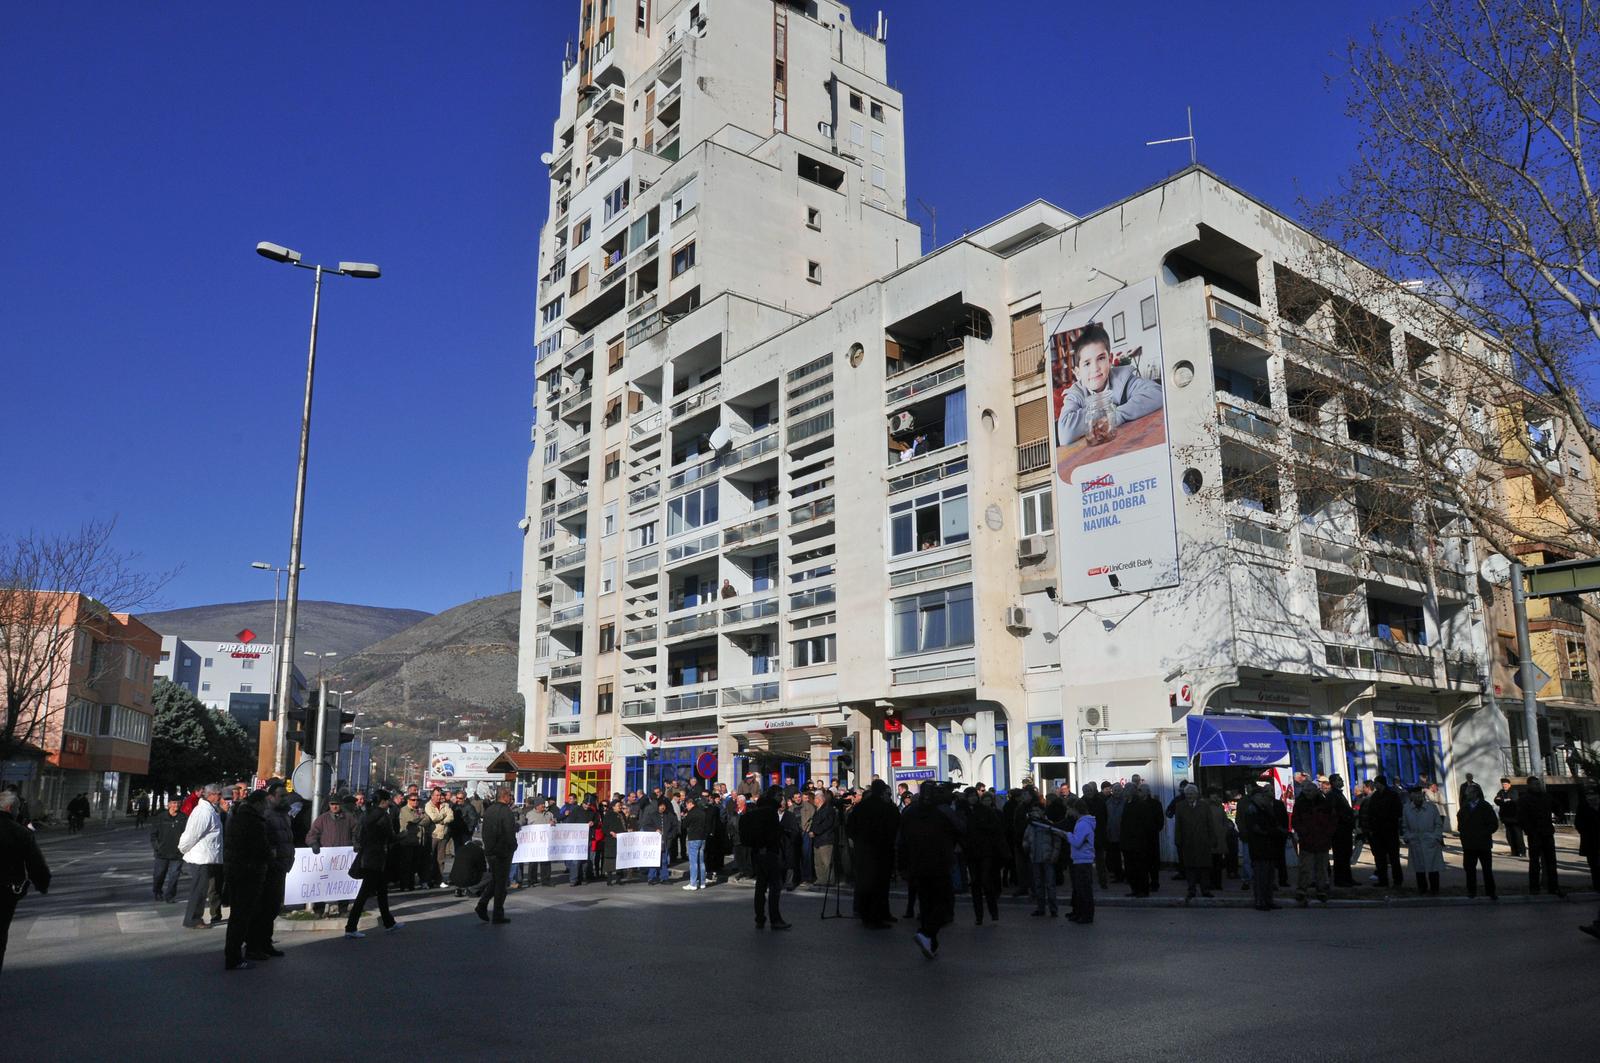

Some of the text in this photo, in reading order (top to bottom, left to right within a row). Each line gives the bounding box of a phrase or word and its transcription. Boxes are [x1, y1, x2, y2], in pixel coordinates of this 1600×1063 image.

[1082, 477, 1157, 505] ŠTEDNJA JESTE
[1083, 494, 1146, 518] MOJA DOBRA
[1084, 514, 1121, 532] NAVIKA.
[1109, 561, 1136, 572] UniCredit
[1136, 558, 1152, 568] Bank
[577, 750, 605, 763] PETICA
[301, 854, 350, 872] GLAS MEDI
[301, 880, 358, 898] GLAS NARODA
